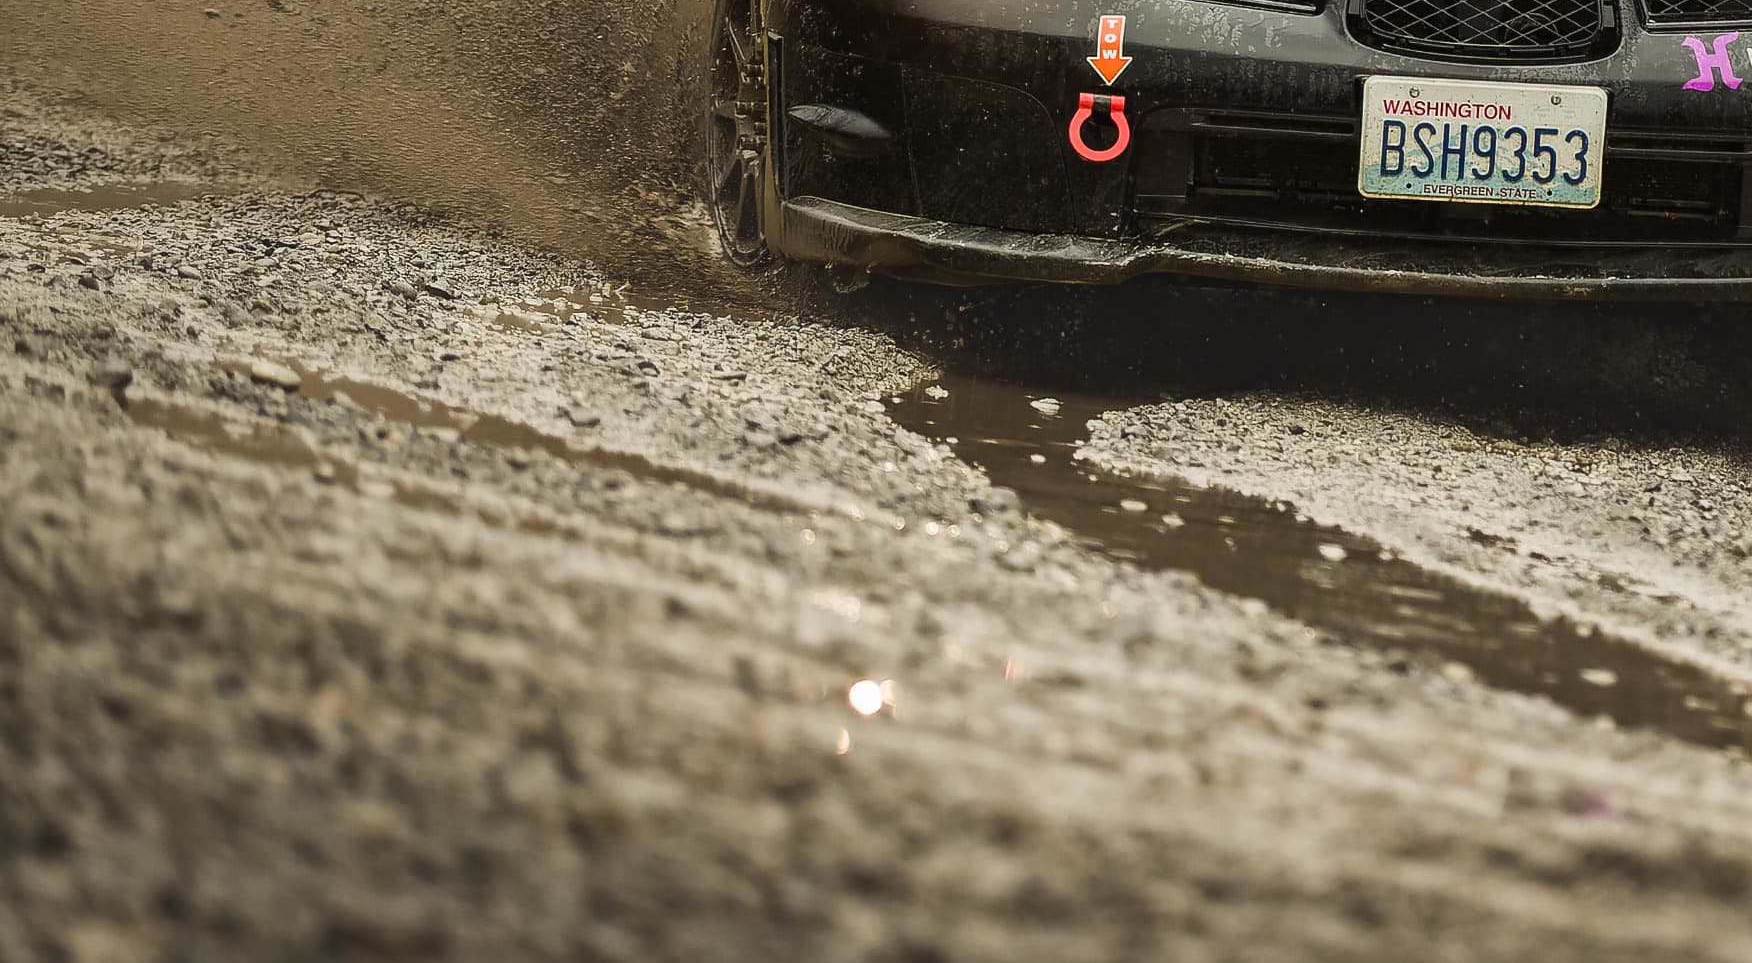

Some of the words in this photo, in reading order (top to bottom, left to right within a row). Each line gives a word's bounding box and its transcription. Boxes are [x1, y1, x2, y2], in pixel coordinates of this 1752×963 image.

[1102, 19, 1118, 60] TOW
[1382, 99, 1513, 120] WASHINGTON
[1380, 120, 1589, 185] BSH9353
[1423, 184, 1494, 197] EVERGREEN
[1499, 188, 1537, 199] STATE
